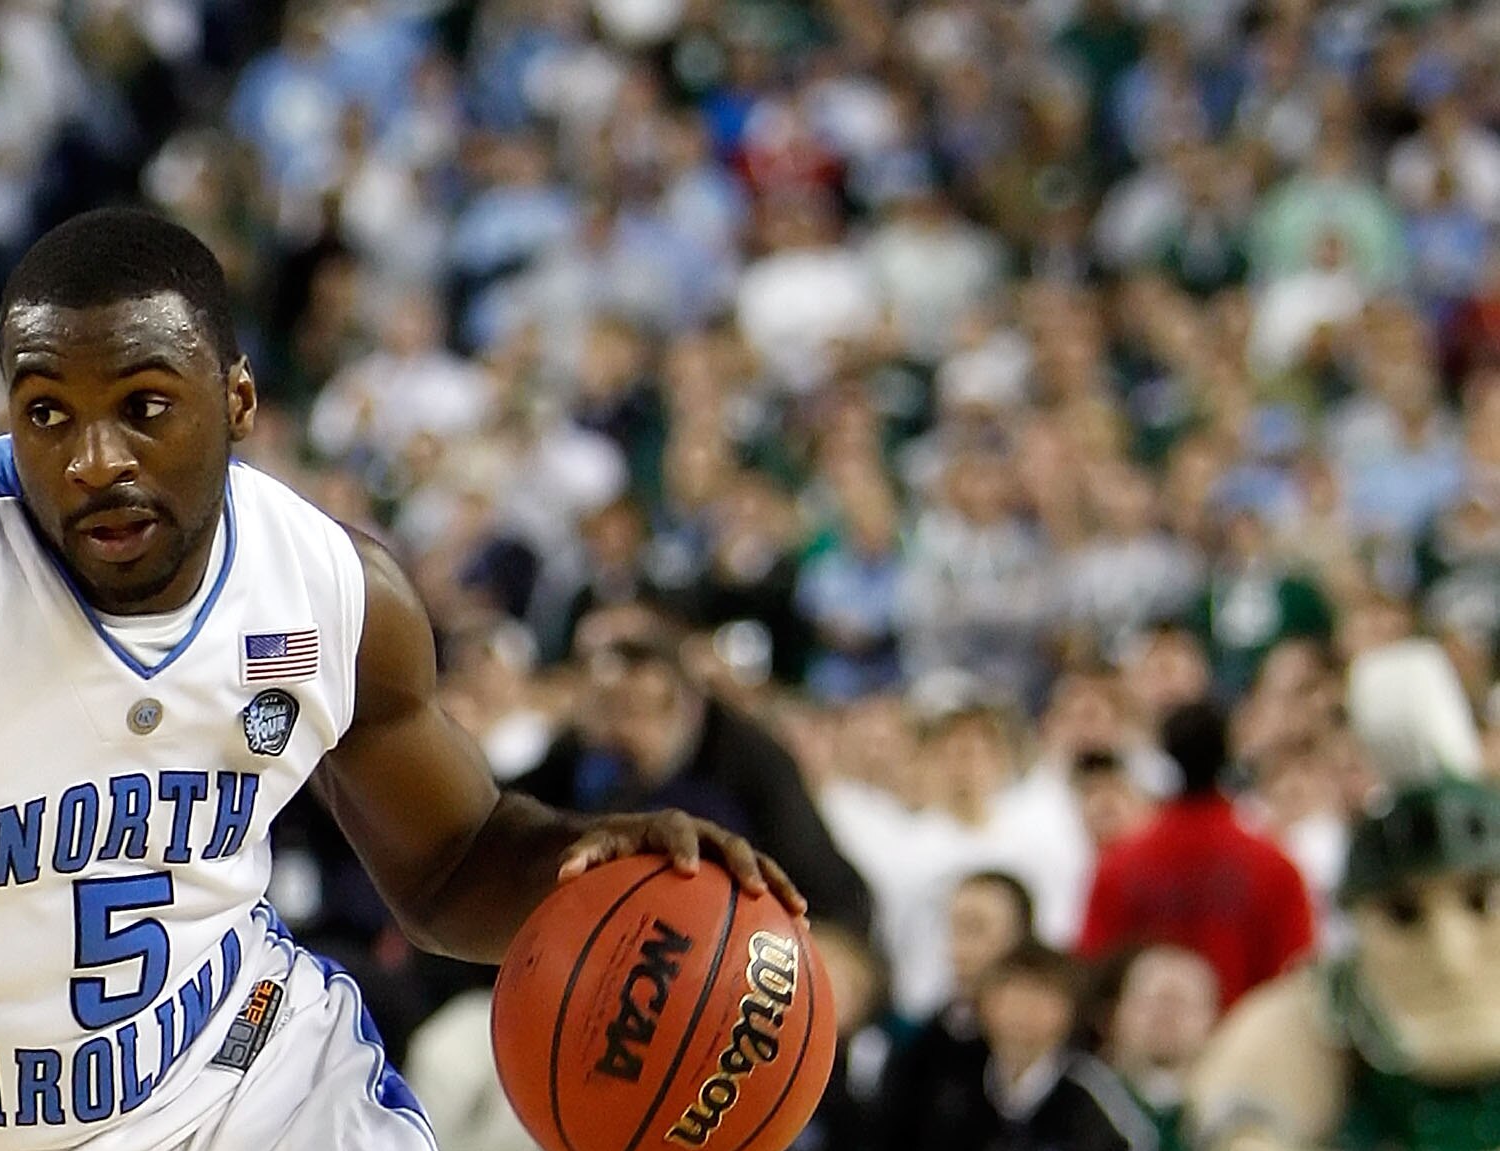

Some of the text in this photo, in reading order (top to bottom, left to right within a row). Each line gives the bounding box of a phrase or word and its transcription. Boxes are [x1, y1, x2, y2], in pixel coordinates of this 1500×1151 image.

[69, 870, 175, 1030] 5
[594, 918, 694, 1083] NCAA
[664, 930, 799, 1148] Wilson
